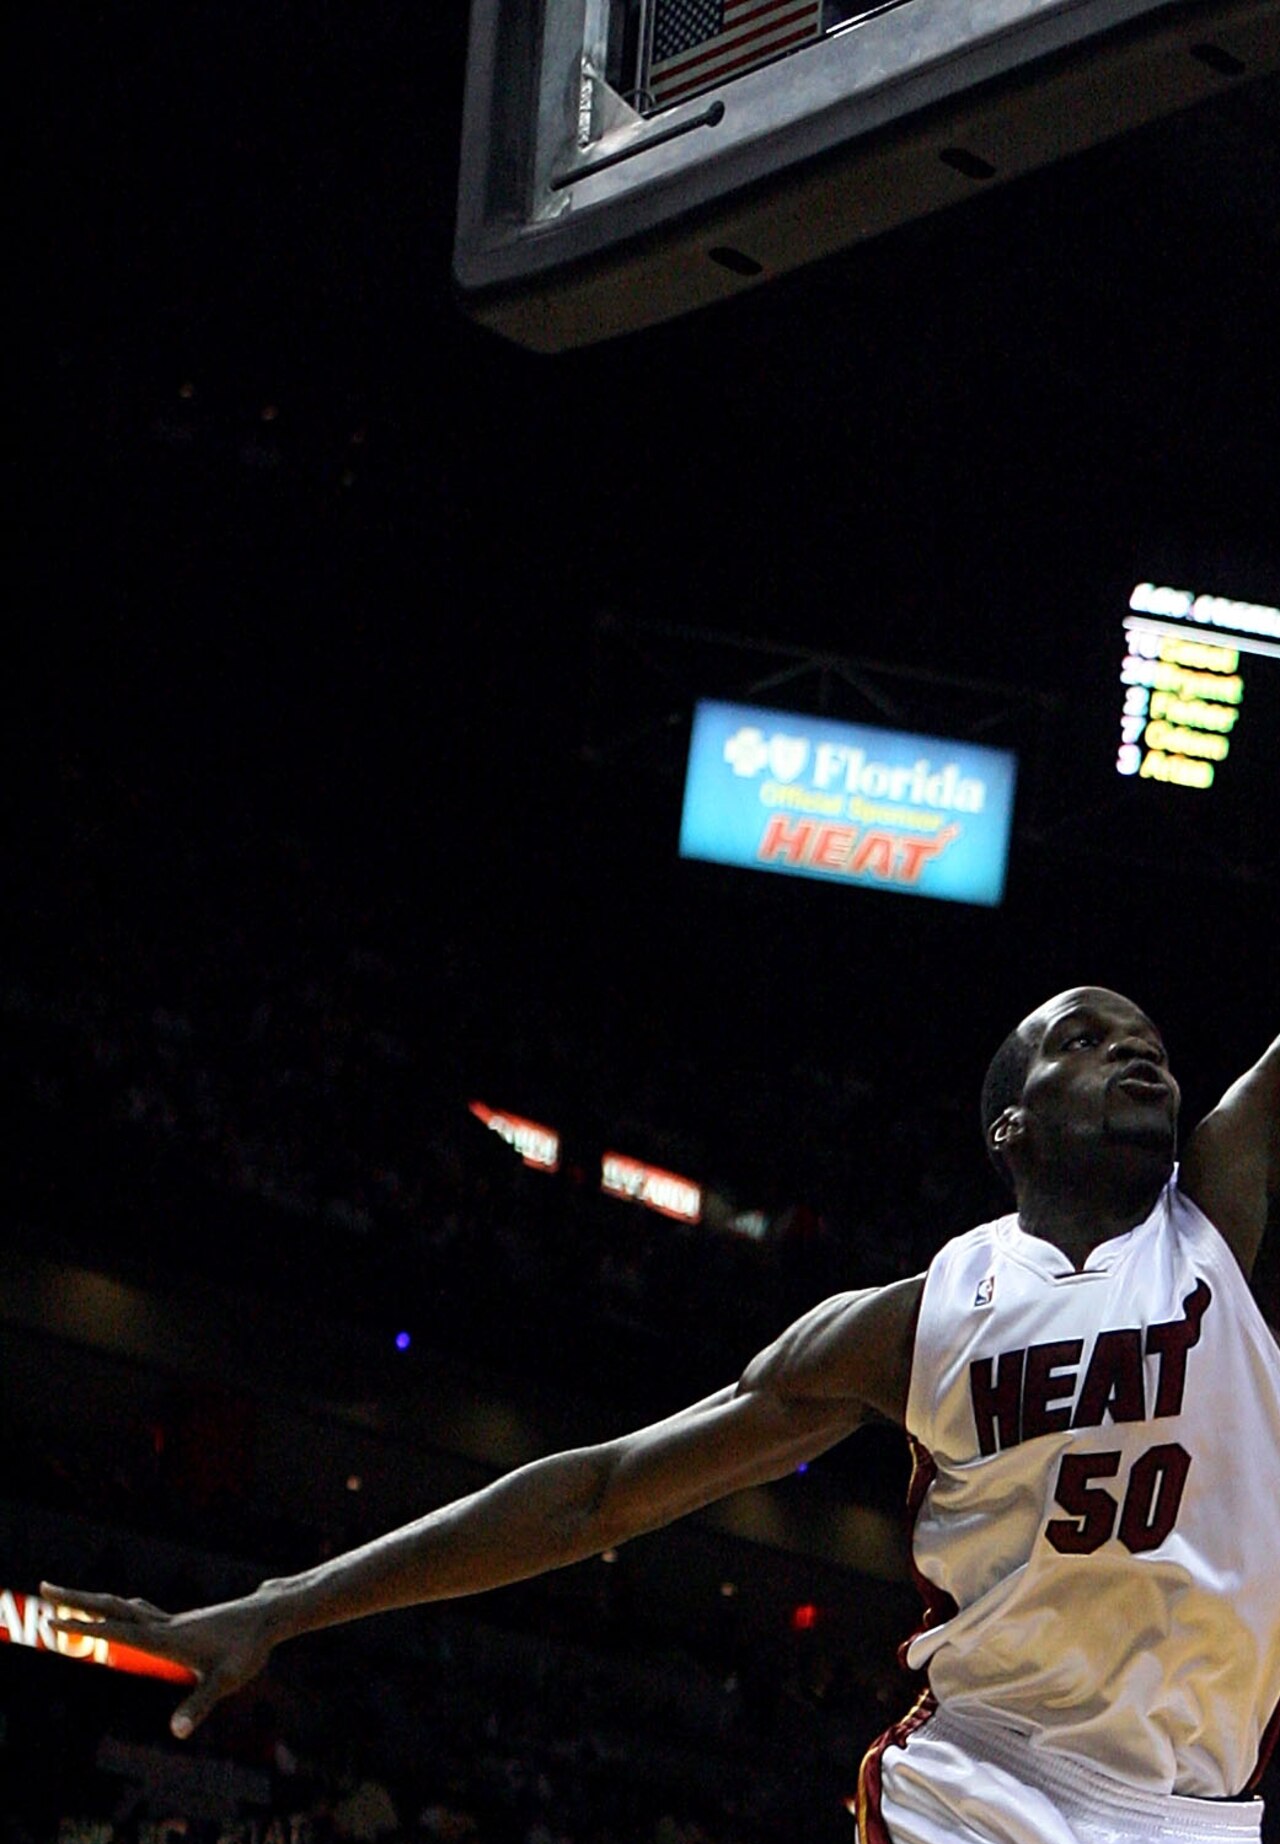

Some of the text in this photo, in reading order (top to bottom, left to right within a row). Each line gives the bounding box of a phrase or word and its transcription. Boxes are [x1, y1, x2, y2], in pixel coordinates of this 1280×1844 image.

[811, 740, 989, 815] Florida
[756, 812, 961, 886] HEAT
[969, 1277, 1212, 1458] HEAT
[1044, 1441, 1193, 1556] 50
